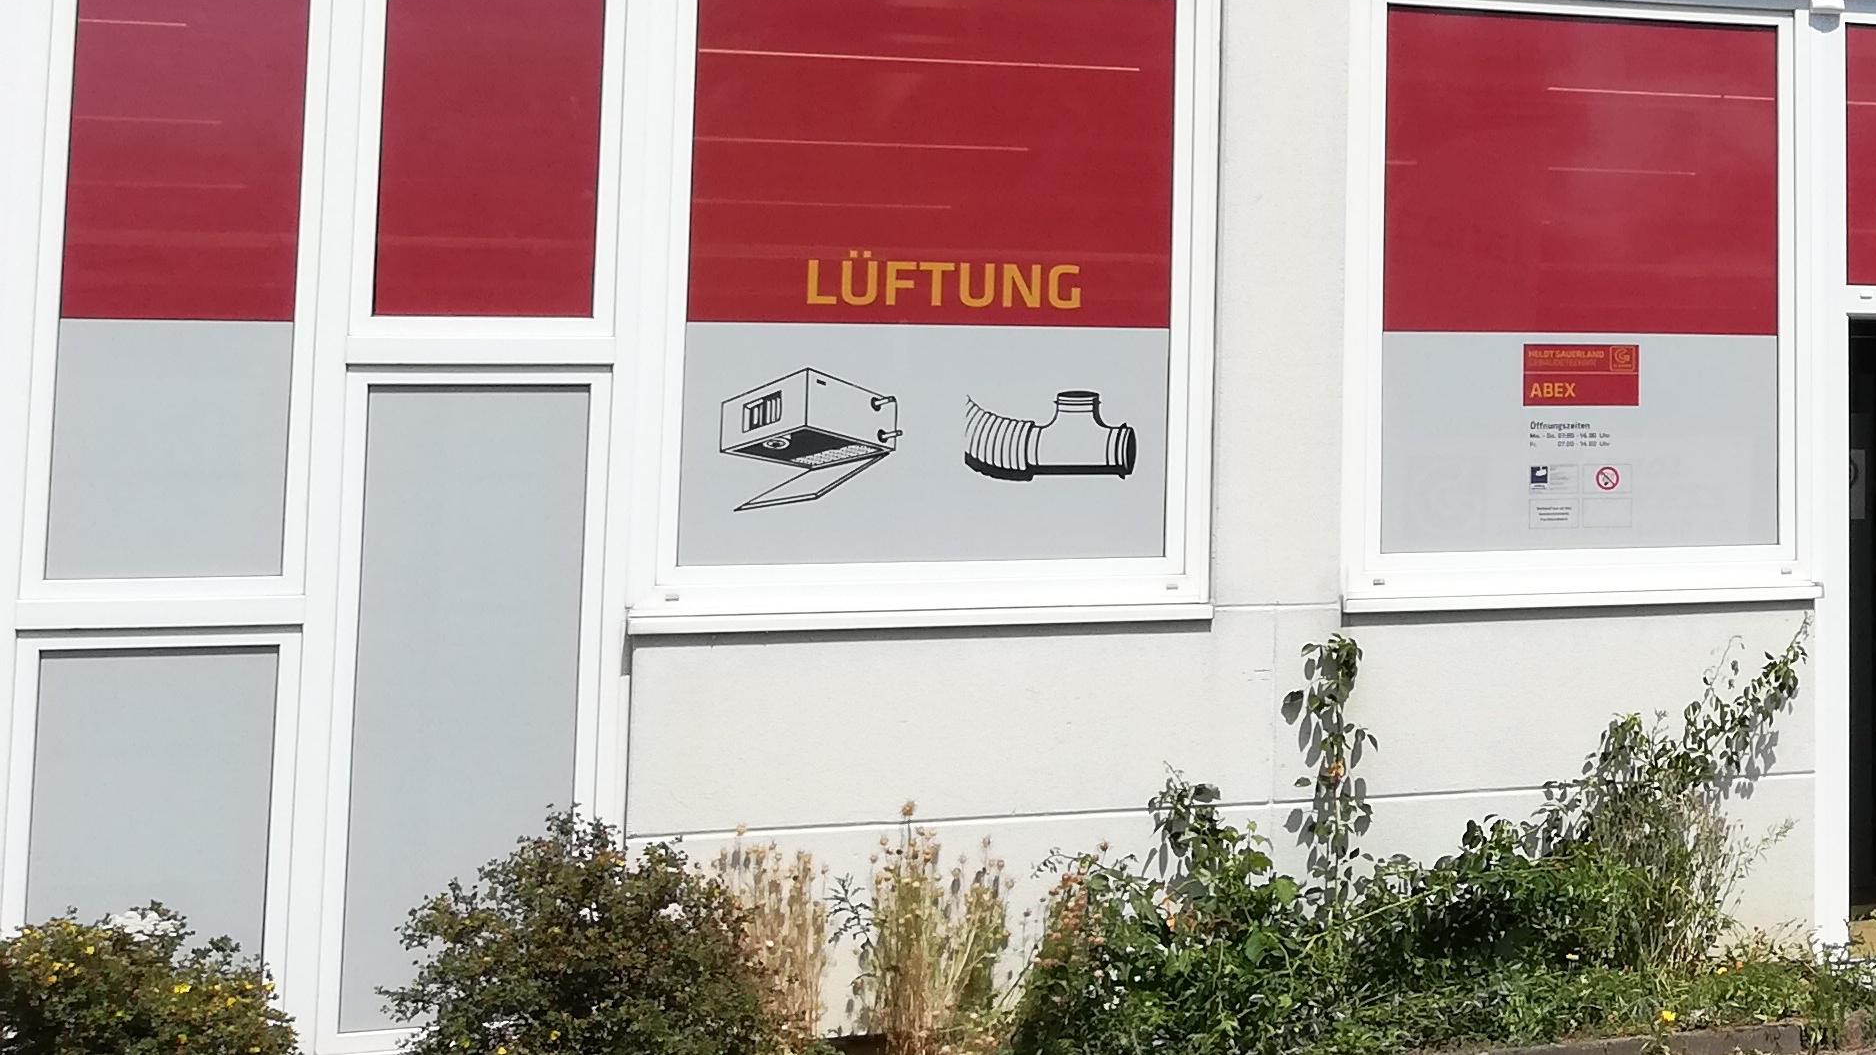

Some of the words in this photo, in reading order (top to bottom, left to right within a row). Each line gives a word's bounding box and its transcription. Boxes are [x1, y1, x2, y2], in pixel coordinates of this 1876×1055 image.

[806, 250, 1082, 309] LÜFTUNG
[1530, 383, 1576, 398] ABEX
[1530, 420, 1591, 431] Öffnungszeiten
